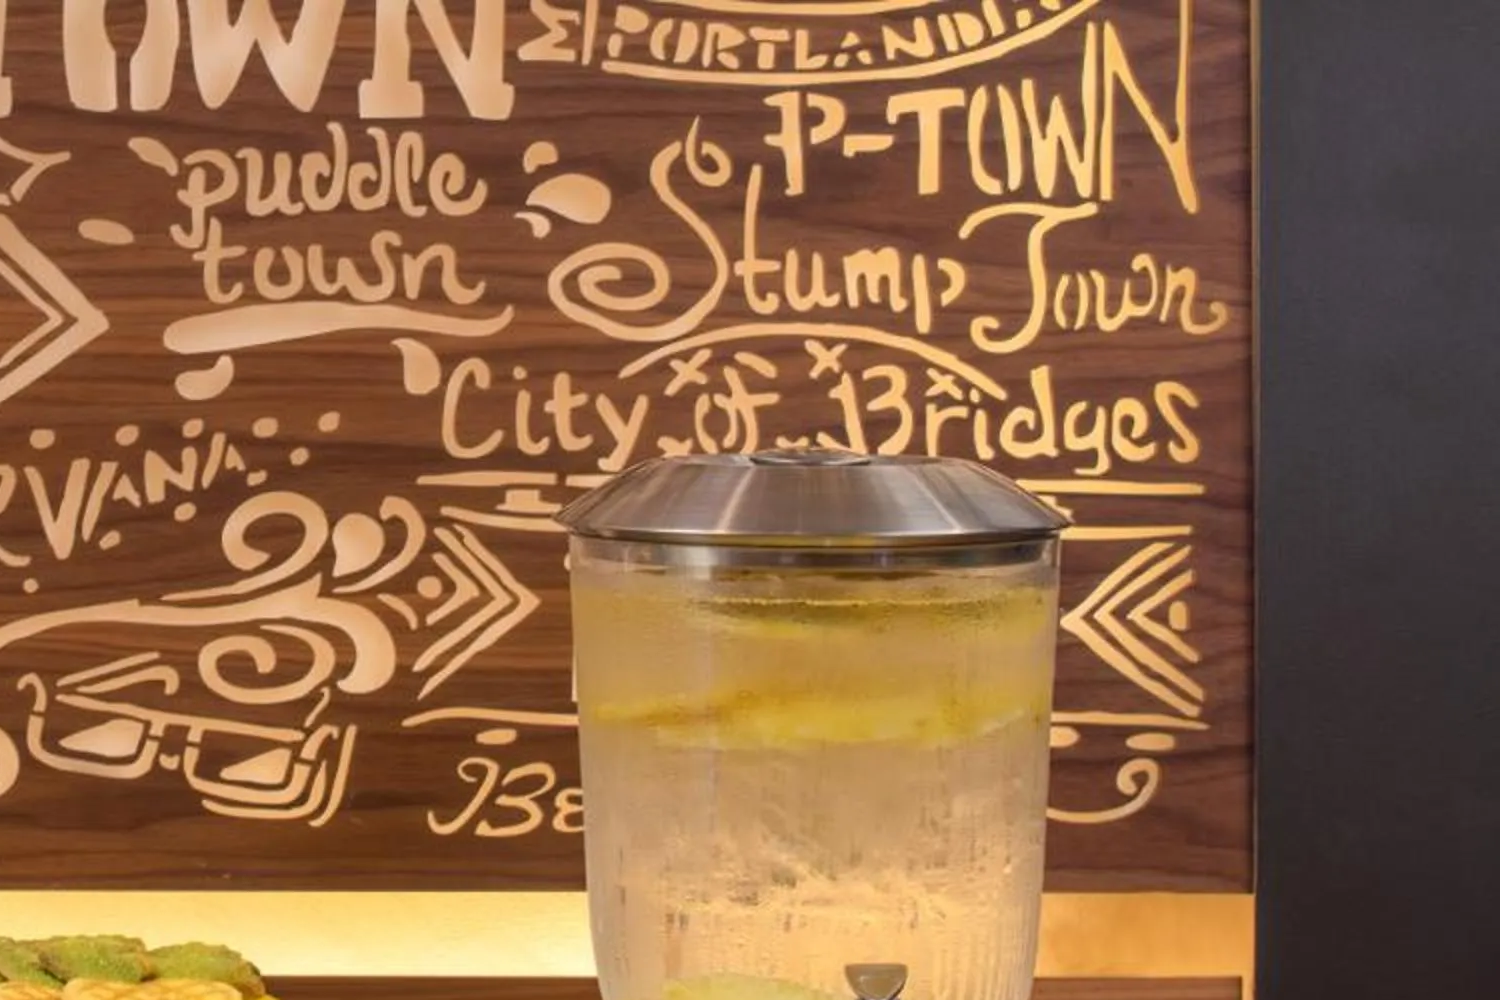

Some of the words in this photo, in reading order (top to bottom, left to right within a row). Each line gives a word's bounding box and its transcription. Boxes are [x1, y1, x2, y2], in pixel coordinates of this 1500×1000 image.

[763, 0, 1198, 214] P-TOWN
[170, 122, 489, 250] puddle
[547, 115, 966, 342] Stump
[958, 202, 1228, 354] Town
[192, 217, 487, 304] town
[441, 357, 650, 472] City
[694, 365, 781, 455] of
[817, 363, 1202, 475] Bridges
